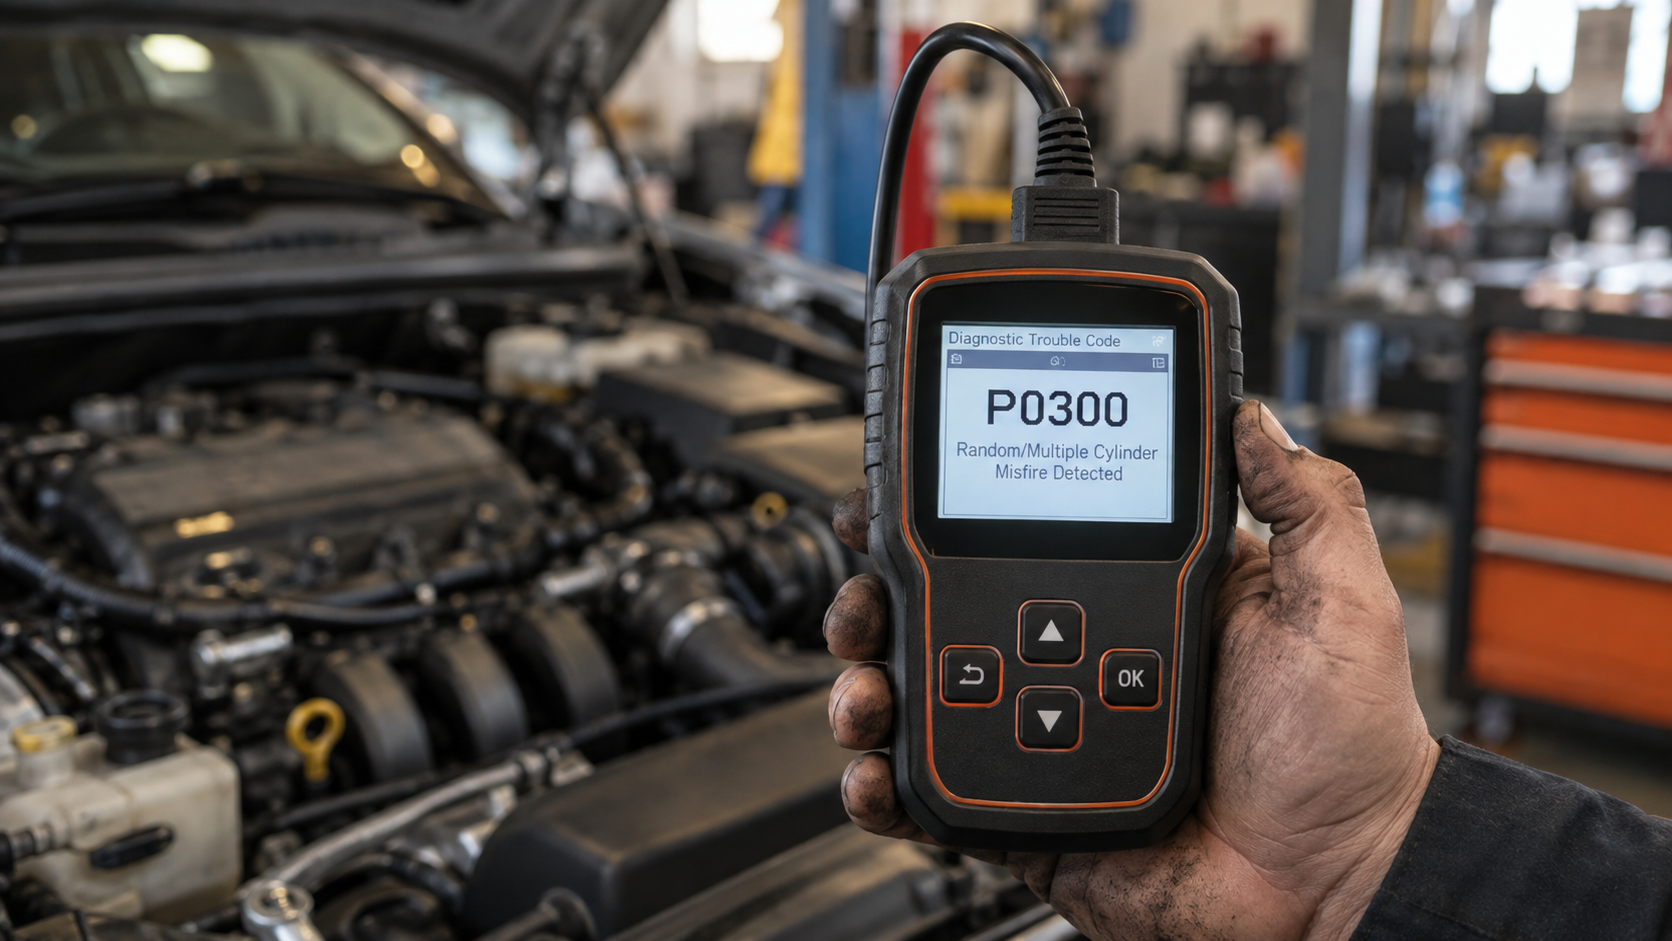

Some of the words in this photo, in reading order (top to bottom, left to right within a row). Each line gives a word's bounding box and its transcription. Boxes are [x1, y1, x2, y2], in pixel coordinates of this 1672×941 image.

[949, 331, 1024, 347] Diagnostic
[1028, 333, 1081, 347] Trouble
[1085, 334, 1121, 347] Code
[987, 389, 1128, 427] P0300
[957, 442, 1089, 462] Random/Multiple
[1094, 444, 1158, 462] Cylinder
[995, 464, 1048, 480] Misfire
[1053, 465, 1123, 481] Detected
[1118, 669, 1145, 688] OK
